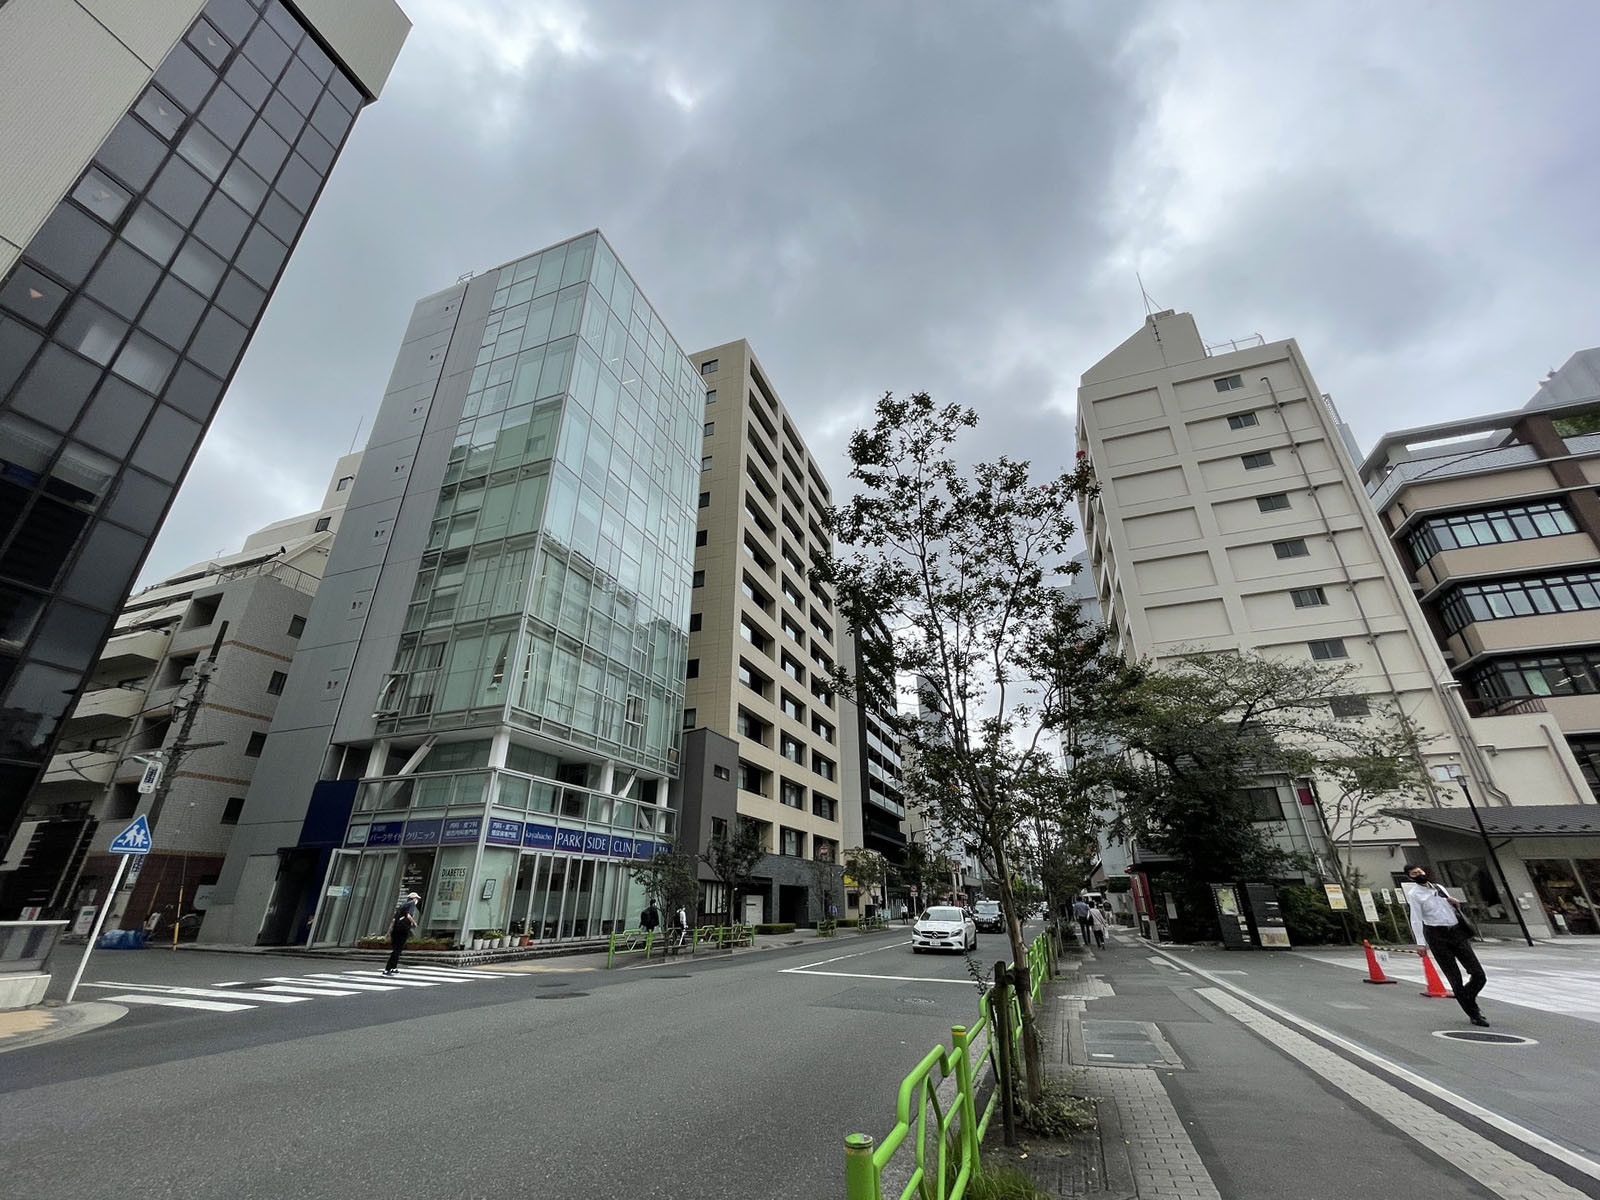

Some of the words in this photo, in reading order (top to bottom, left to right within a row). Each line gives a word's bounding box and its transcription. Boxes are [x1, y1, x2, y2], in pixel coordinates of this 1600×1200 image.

[556, 832, 582, 848] PARK
[586, 836, 607, 851] SIDE
[613, 840, 641, 855] CLINIC
[441, 867, 466, 877] DIABETES
